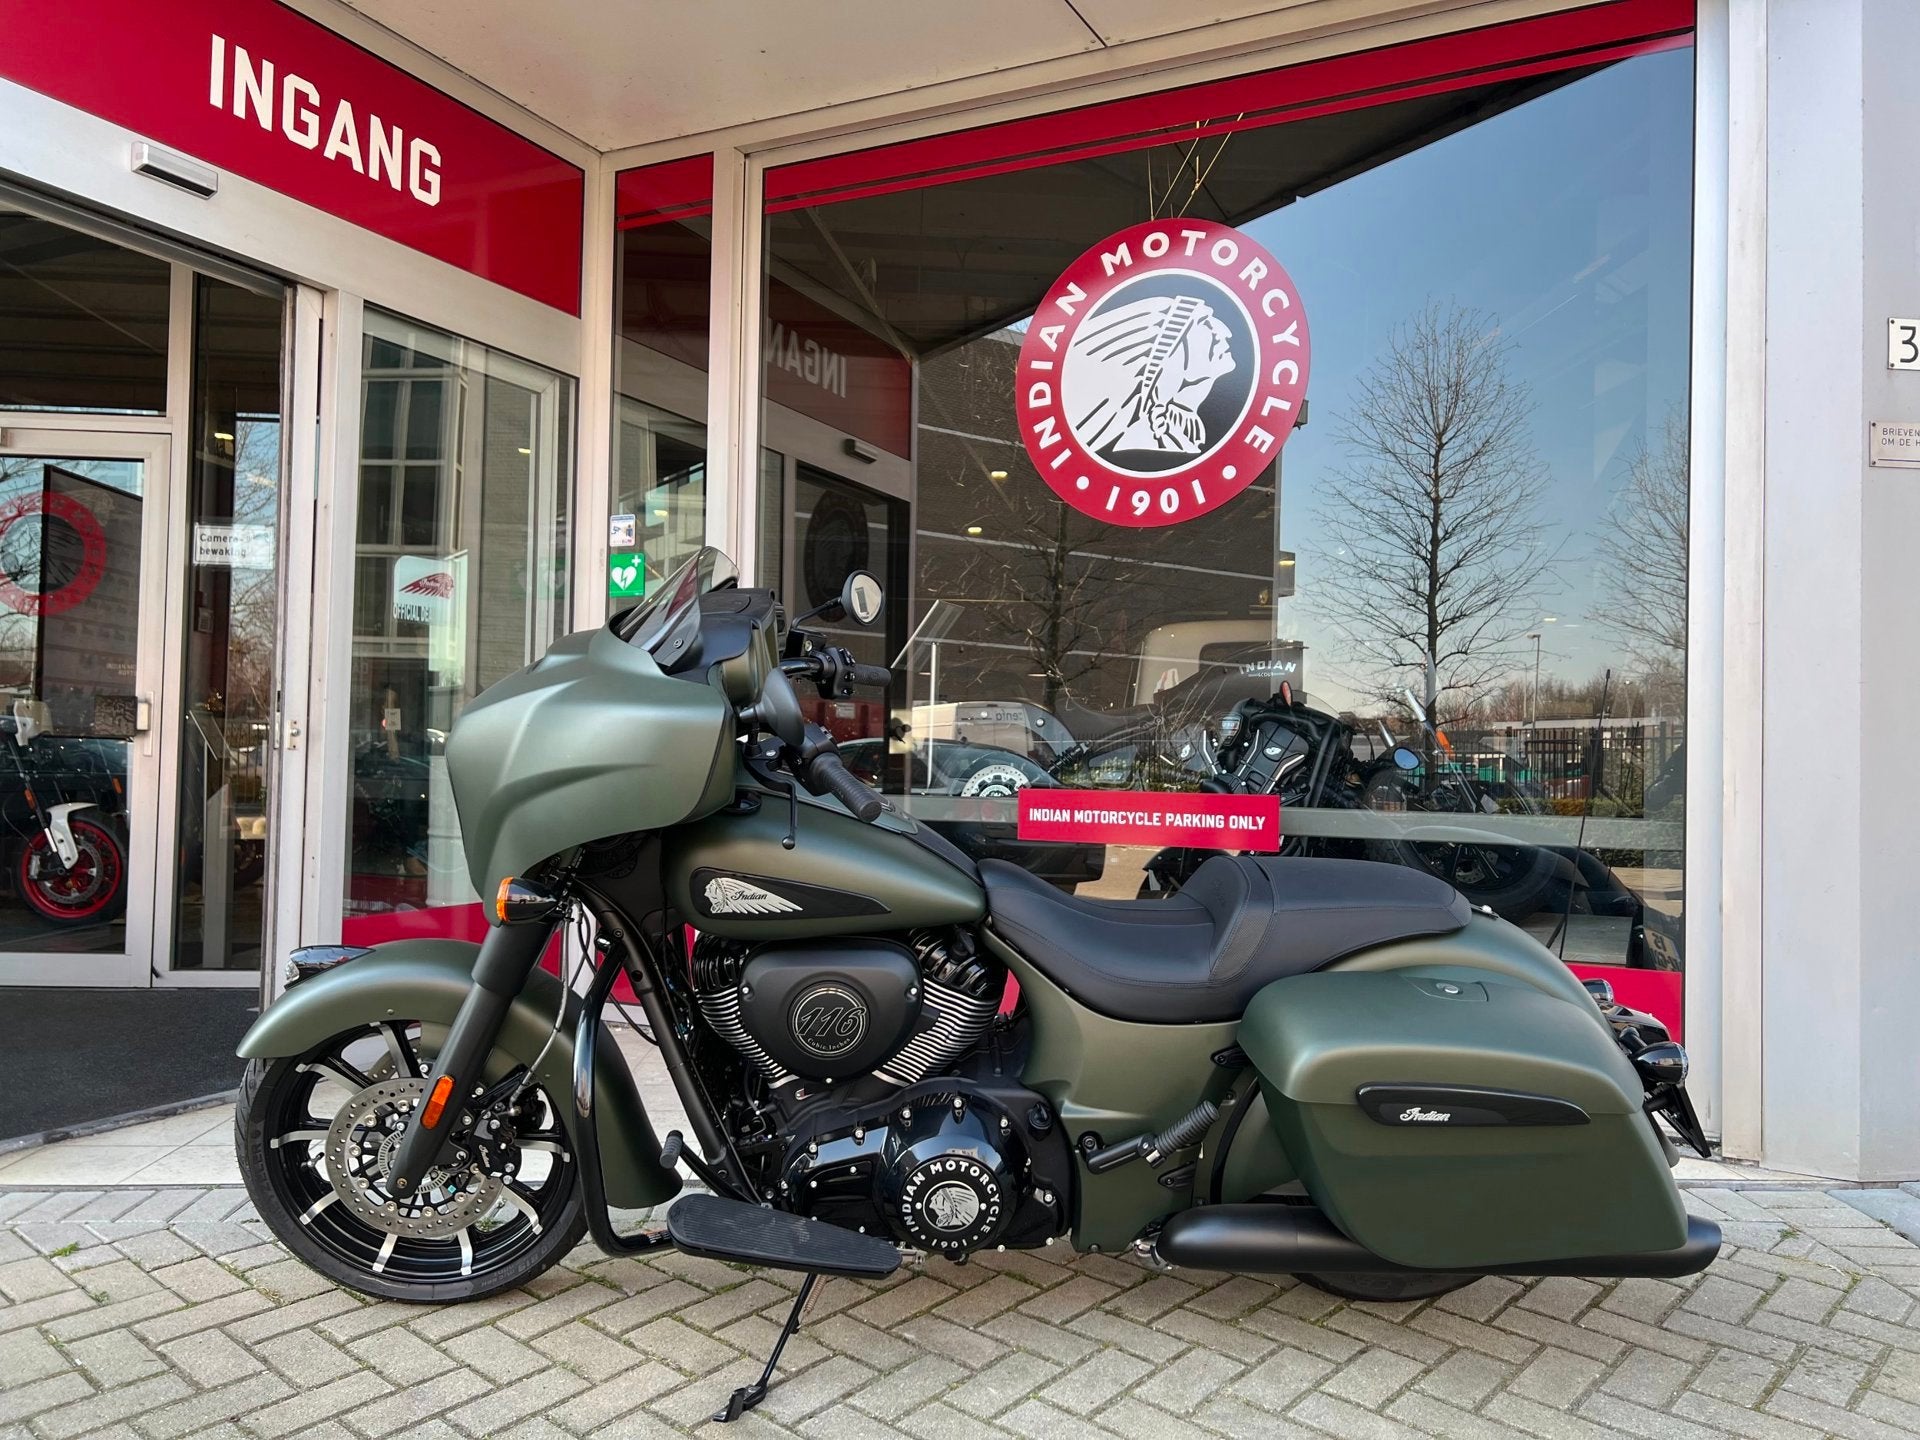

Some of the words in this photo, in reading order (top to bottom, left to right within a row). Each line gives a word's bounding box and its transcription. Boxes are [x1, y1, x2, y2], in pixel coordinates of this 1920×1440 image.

[210, 33, 441, 206] INGANG
[1029, 282, 1087, 469] INDIAN
[1100, 230, 1300, 454] MOTORCYCLE
[1881, 437, 1895, 446] OM
[1899, 438, 1911, 447] DE
[1106, 479, 1205, 516] 1901
[199, 546, 247, 559] bewaking
[393, 603, 420, 621] OFFICIAL
[1239, 660, 1297, 675] INDIAN
[1029, 808, 1070, 822] INDIAN
[1074, 810, 1162, 826] MOTORCYCLE
[1165, 814, 1225, 829] PARKING
[1229, 815, 1266, 830] ONLY
[731, 890, 768, 901] Indian
[797, 1007, 867, 1037] 116
[1399, 1107, 1451, 1122] Indian
[902, 1171, 926, 1233] INDIAN
[929, 1159, 1000, 1234] MOTORCYCLE
[931, 1238, 968, 1249] 1901
